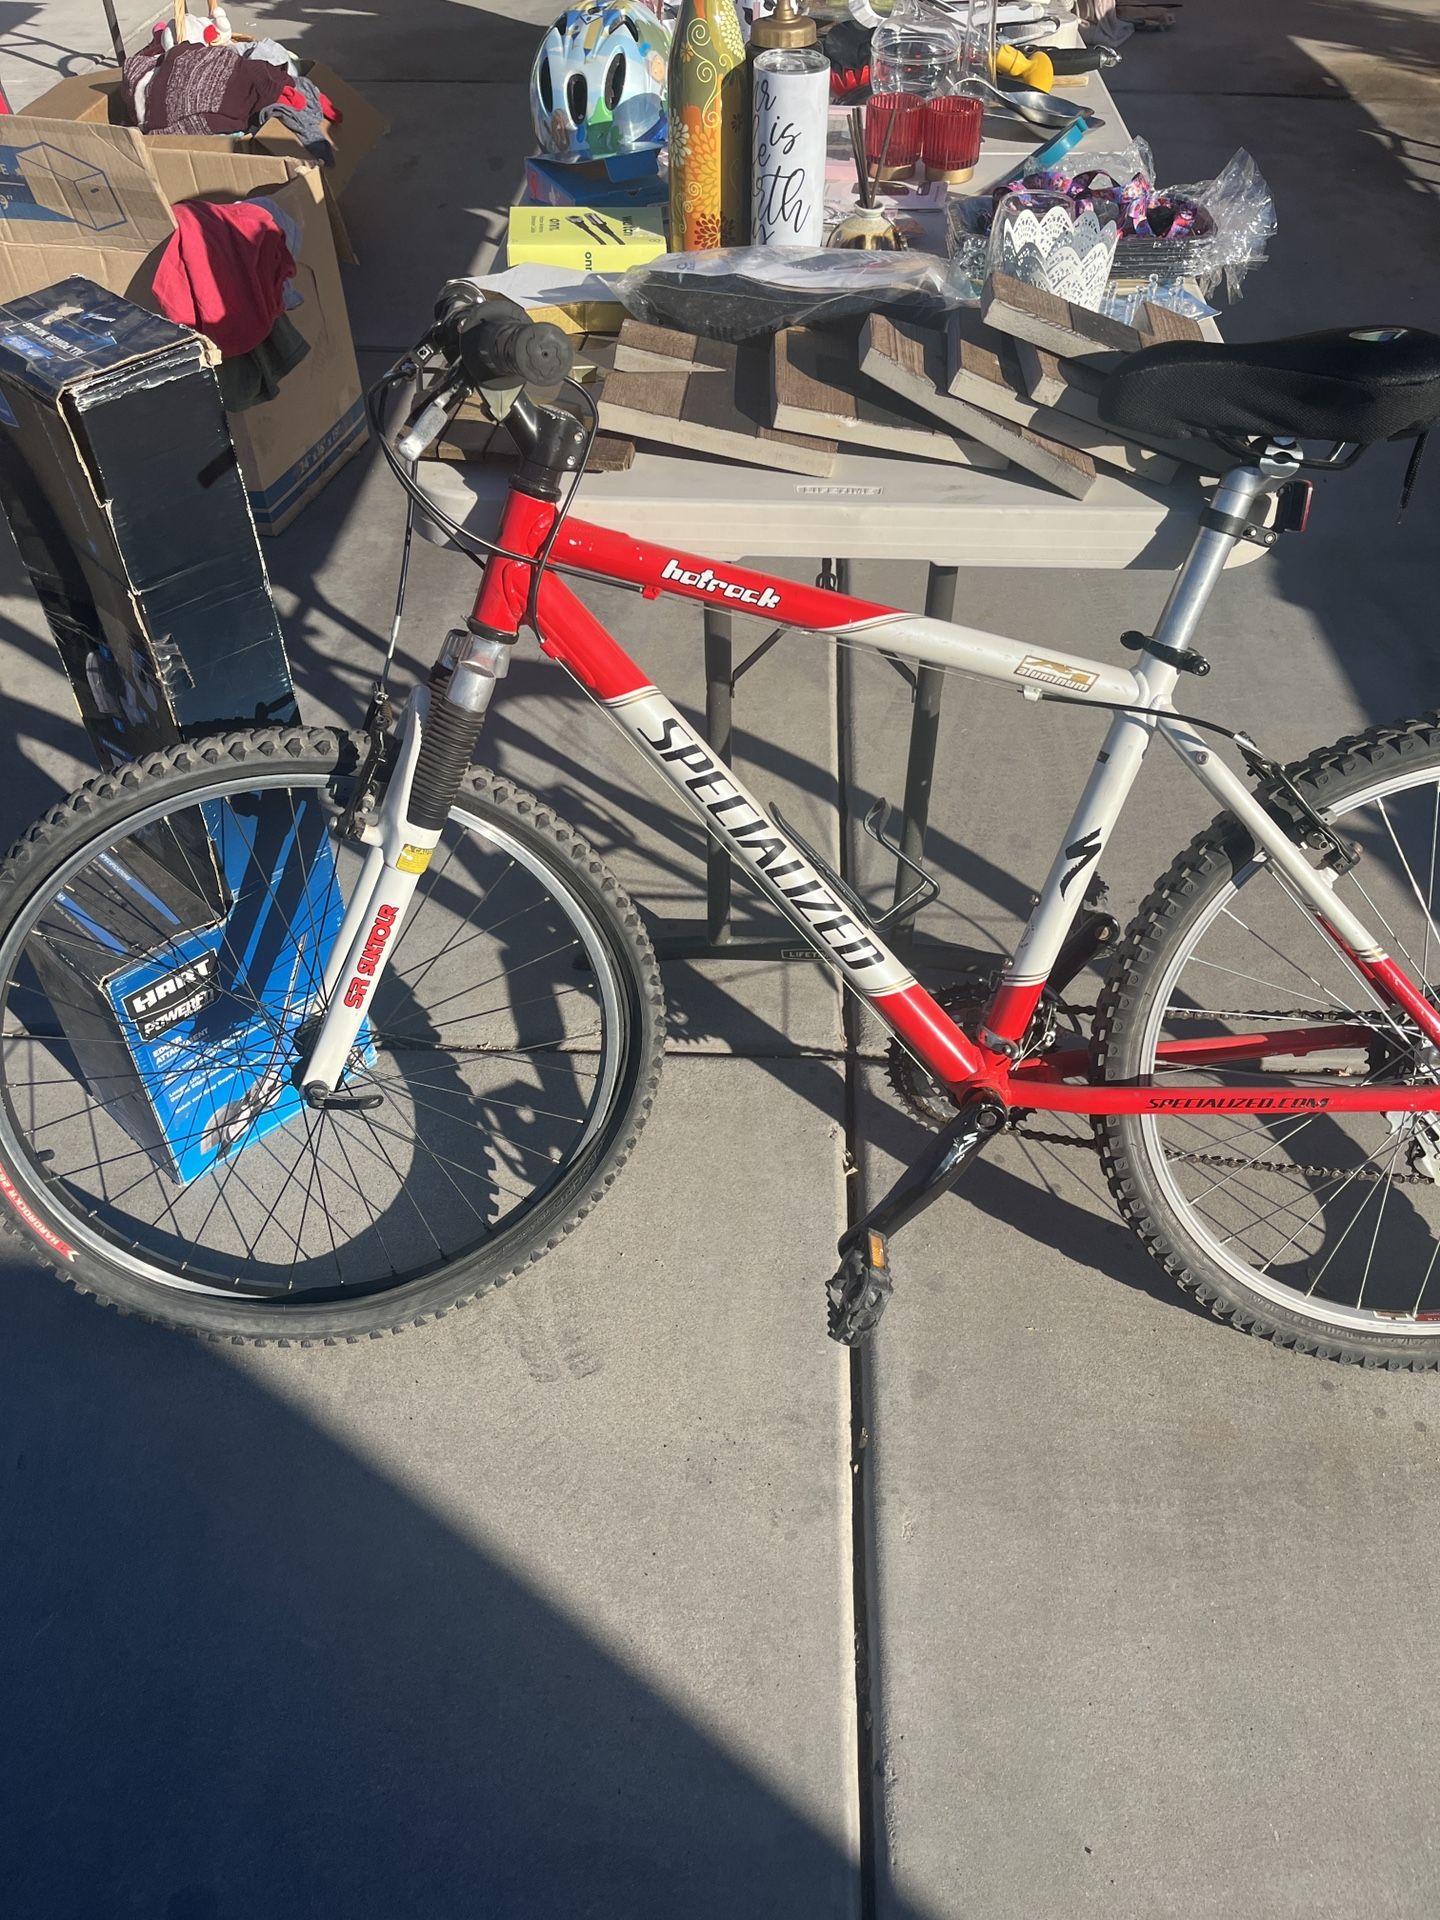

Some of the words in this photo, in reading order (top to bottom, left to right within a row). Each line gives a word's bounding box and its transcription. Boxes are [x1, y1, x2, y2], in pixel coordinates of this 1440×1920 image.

[769, 116, 802, 155] is
[661, 559, 781, 608] hotrock
[1015, 666, 1090, 692] aluminum
[638, 718, 885, 969] SPECIALIZED
[357, 904, 400, 977] SUNTOUR
[132, 958, 210, 1013] HART
[344, 977, 371, 1009] SR
[1146, 1096, 1330, 1109] SPECIALIZED.COM
